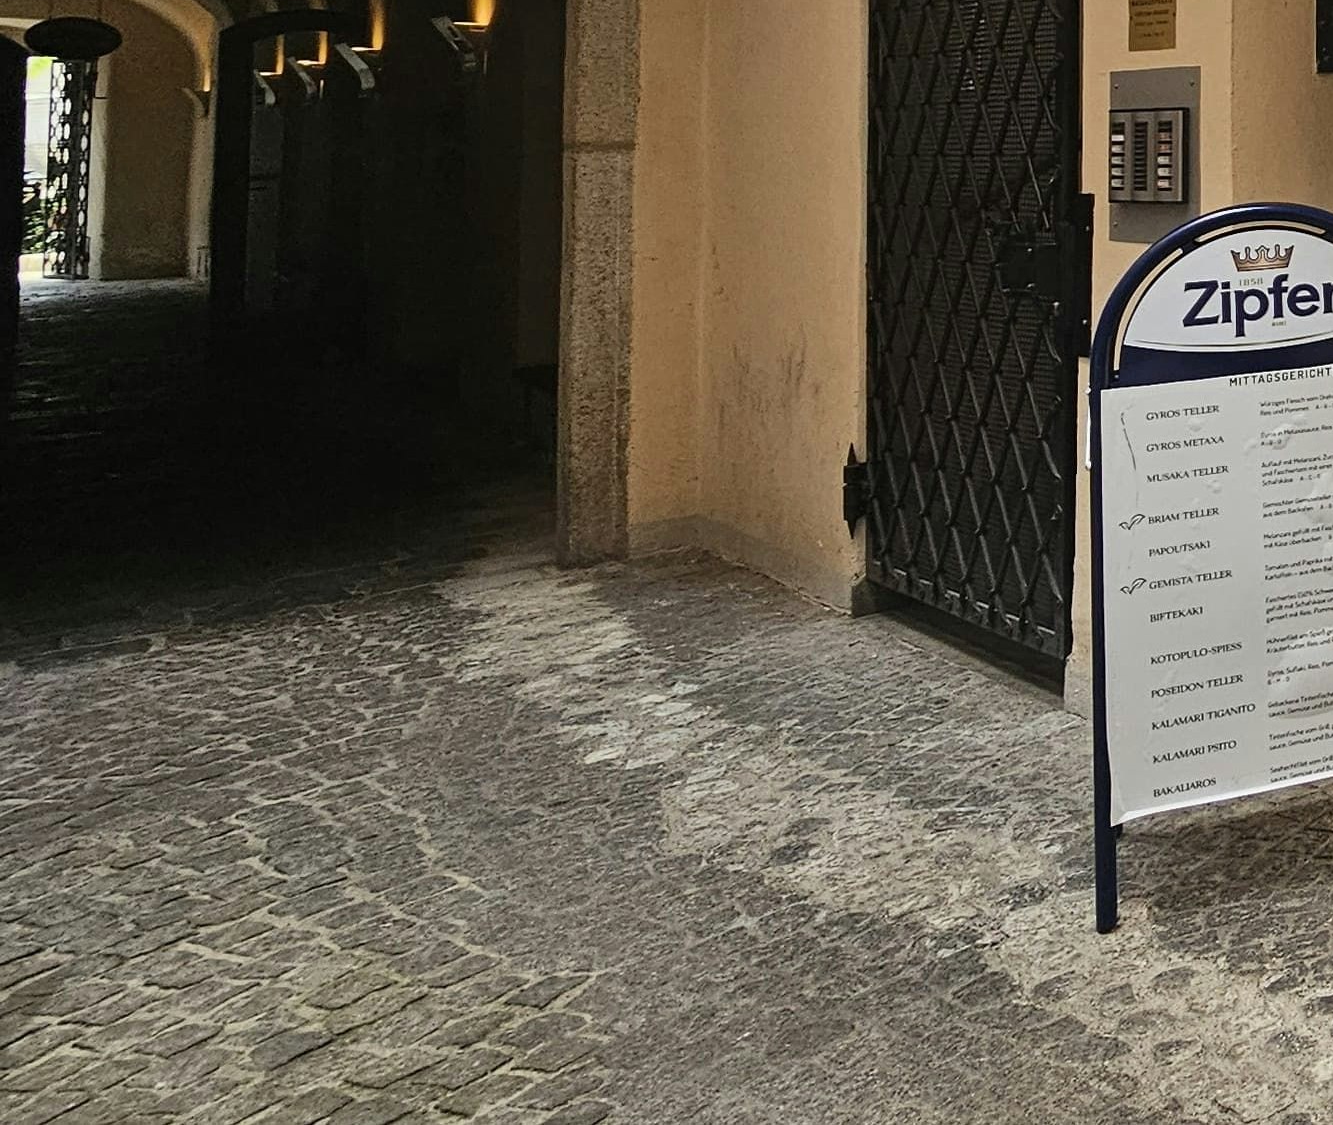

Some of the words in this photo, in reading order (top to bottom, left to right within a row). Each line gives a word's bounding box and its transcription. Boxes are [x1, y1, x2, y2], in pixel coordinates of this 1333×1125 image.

[1146, 409, 1180, 421] GYROS
[1183, 405, 1220, 416] TELLER
[1146, 440, 1181, 452] GYROS
[1183, 436, 1225, 448] METAXA
[1146, 471, 1190, 483] MUSAKA
[1192, 465, 1229, 477] TELLER
[1148, 513, 1180, 524] BRIAM
[1183, 507, 1219, 520] TELLER
[1149, 540, 1211, 557] PAPOUTSAKI
[1149, 576, 1193, 590] GEMISTA
[1195, 570, 1232, 583] TELLER
[1150, 606, 1203, 623] BIFTEKAKI
[1150, 642, 1242, 665] KOTOPULO-SPIESS
[1151, 682, 1204, 698] POSEIDON
[1206, 674, 1243, 689] TELLER
[1151, 713, 1204, 731] KALAMARI
[1206, 703, 1256, 720] TIGANITO
[1152, 746, 1205, 764] KALAMARI
[1207, 740, 1237, 753] PSITO
[1153, 777, 1217, 798] BAKALIAROS
